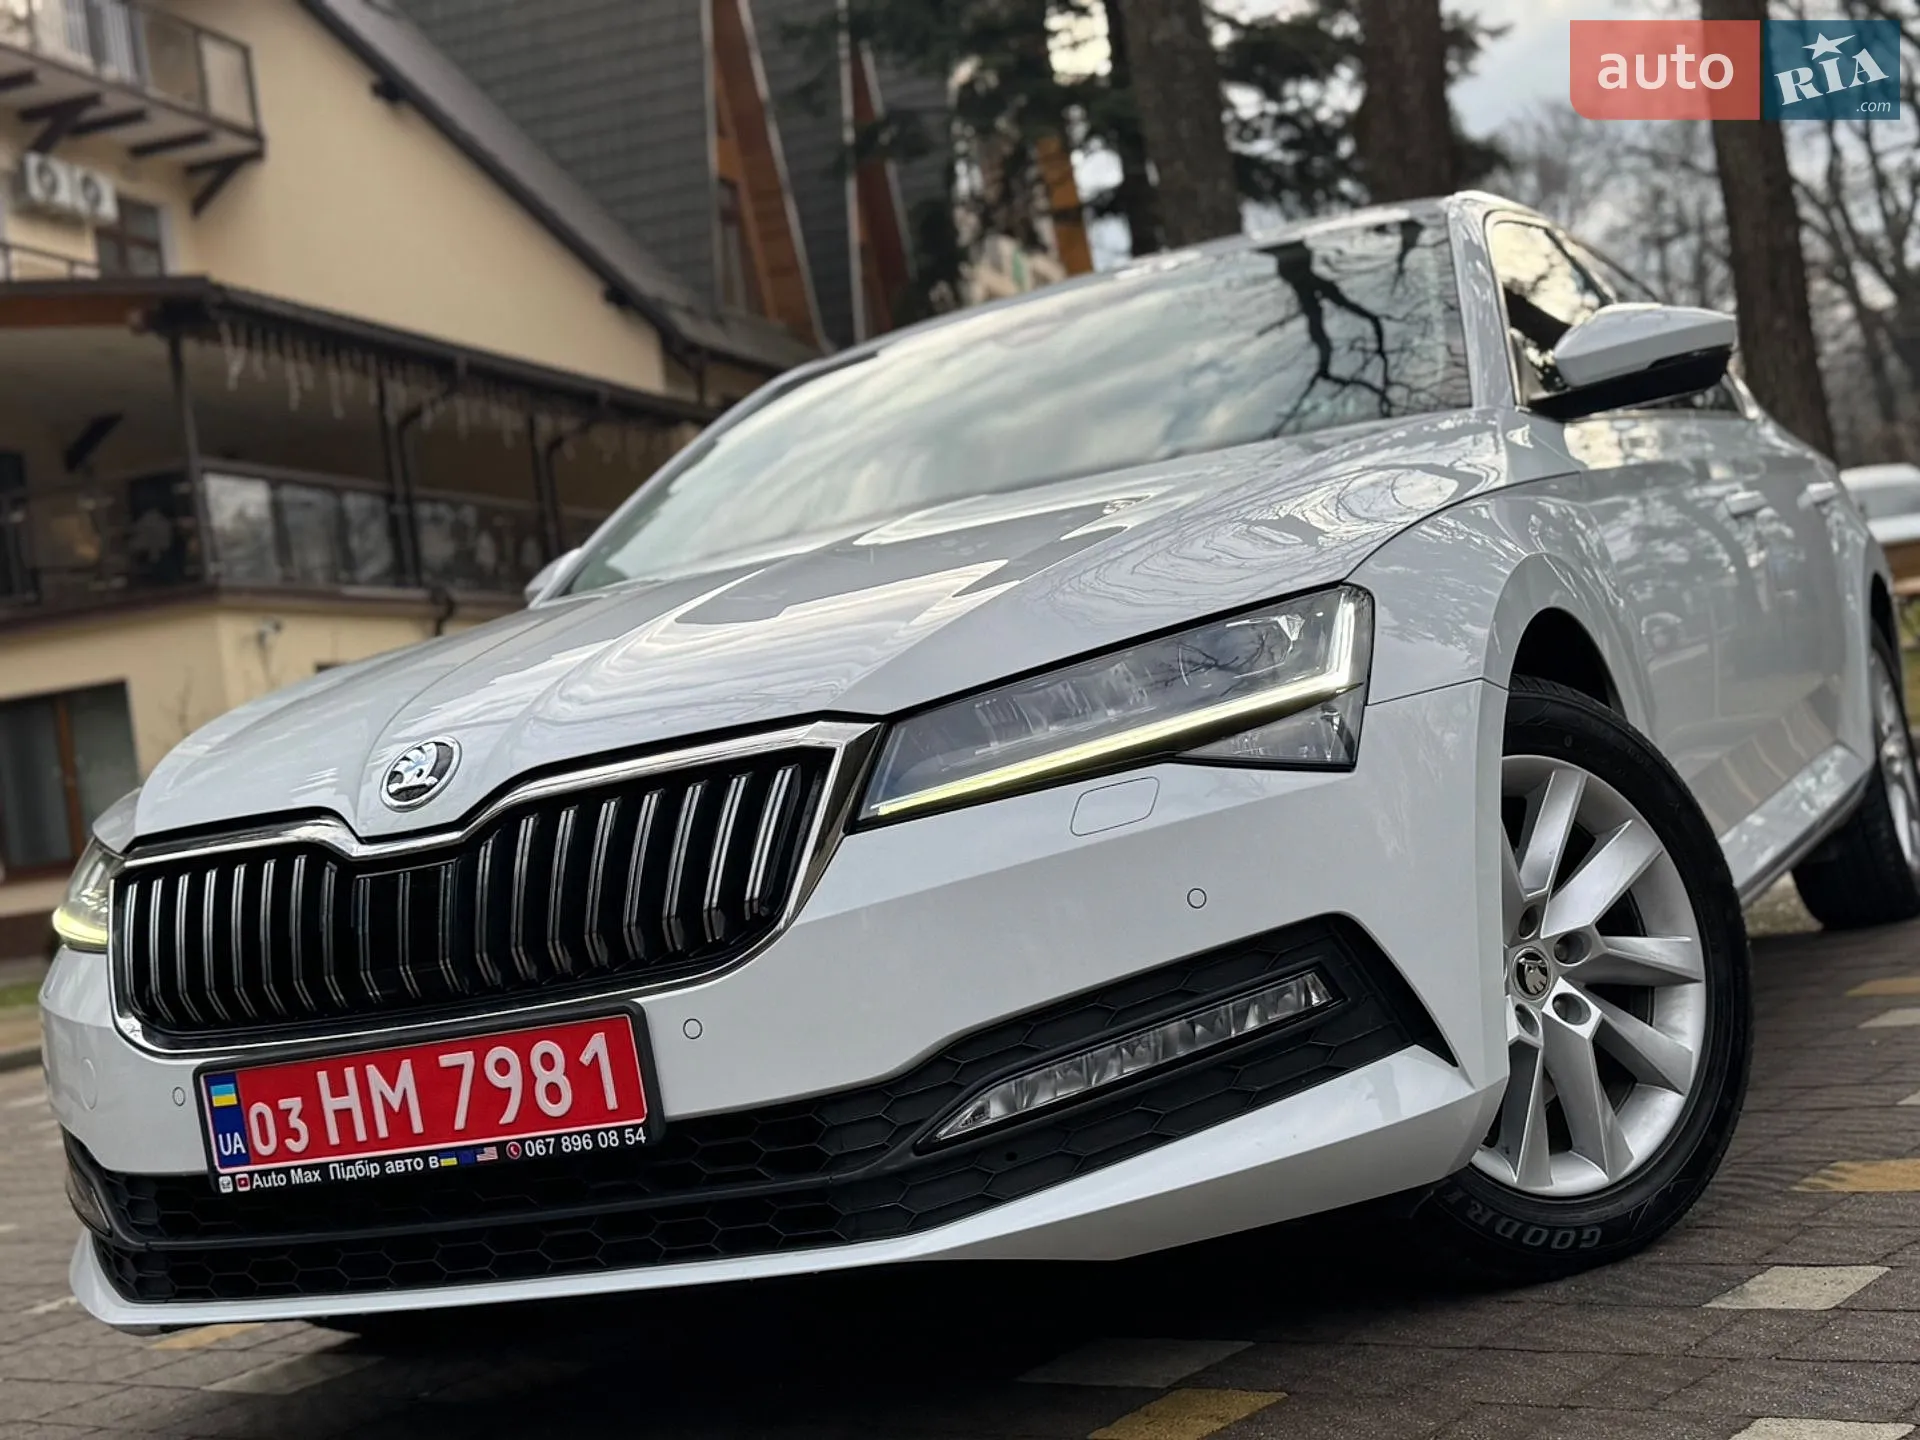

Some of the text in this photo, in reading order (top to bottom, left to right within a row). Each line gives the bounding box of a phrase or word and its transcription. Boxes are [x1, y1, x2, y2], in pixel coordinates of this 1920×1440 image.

[218, 1032, 618, 1157] UA 03 HM 7981
[252, 1127, 647, 1189] Auto Max Підбір авто в 067 896 08 54
